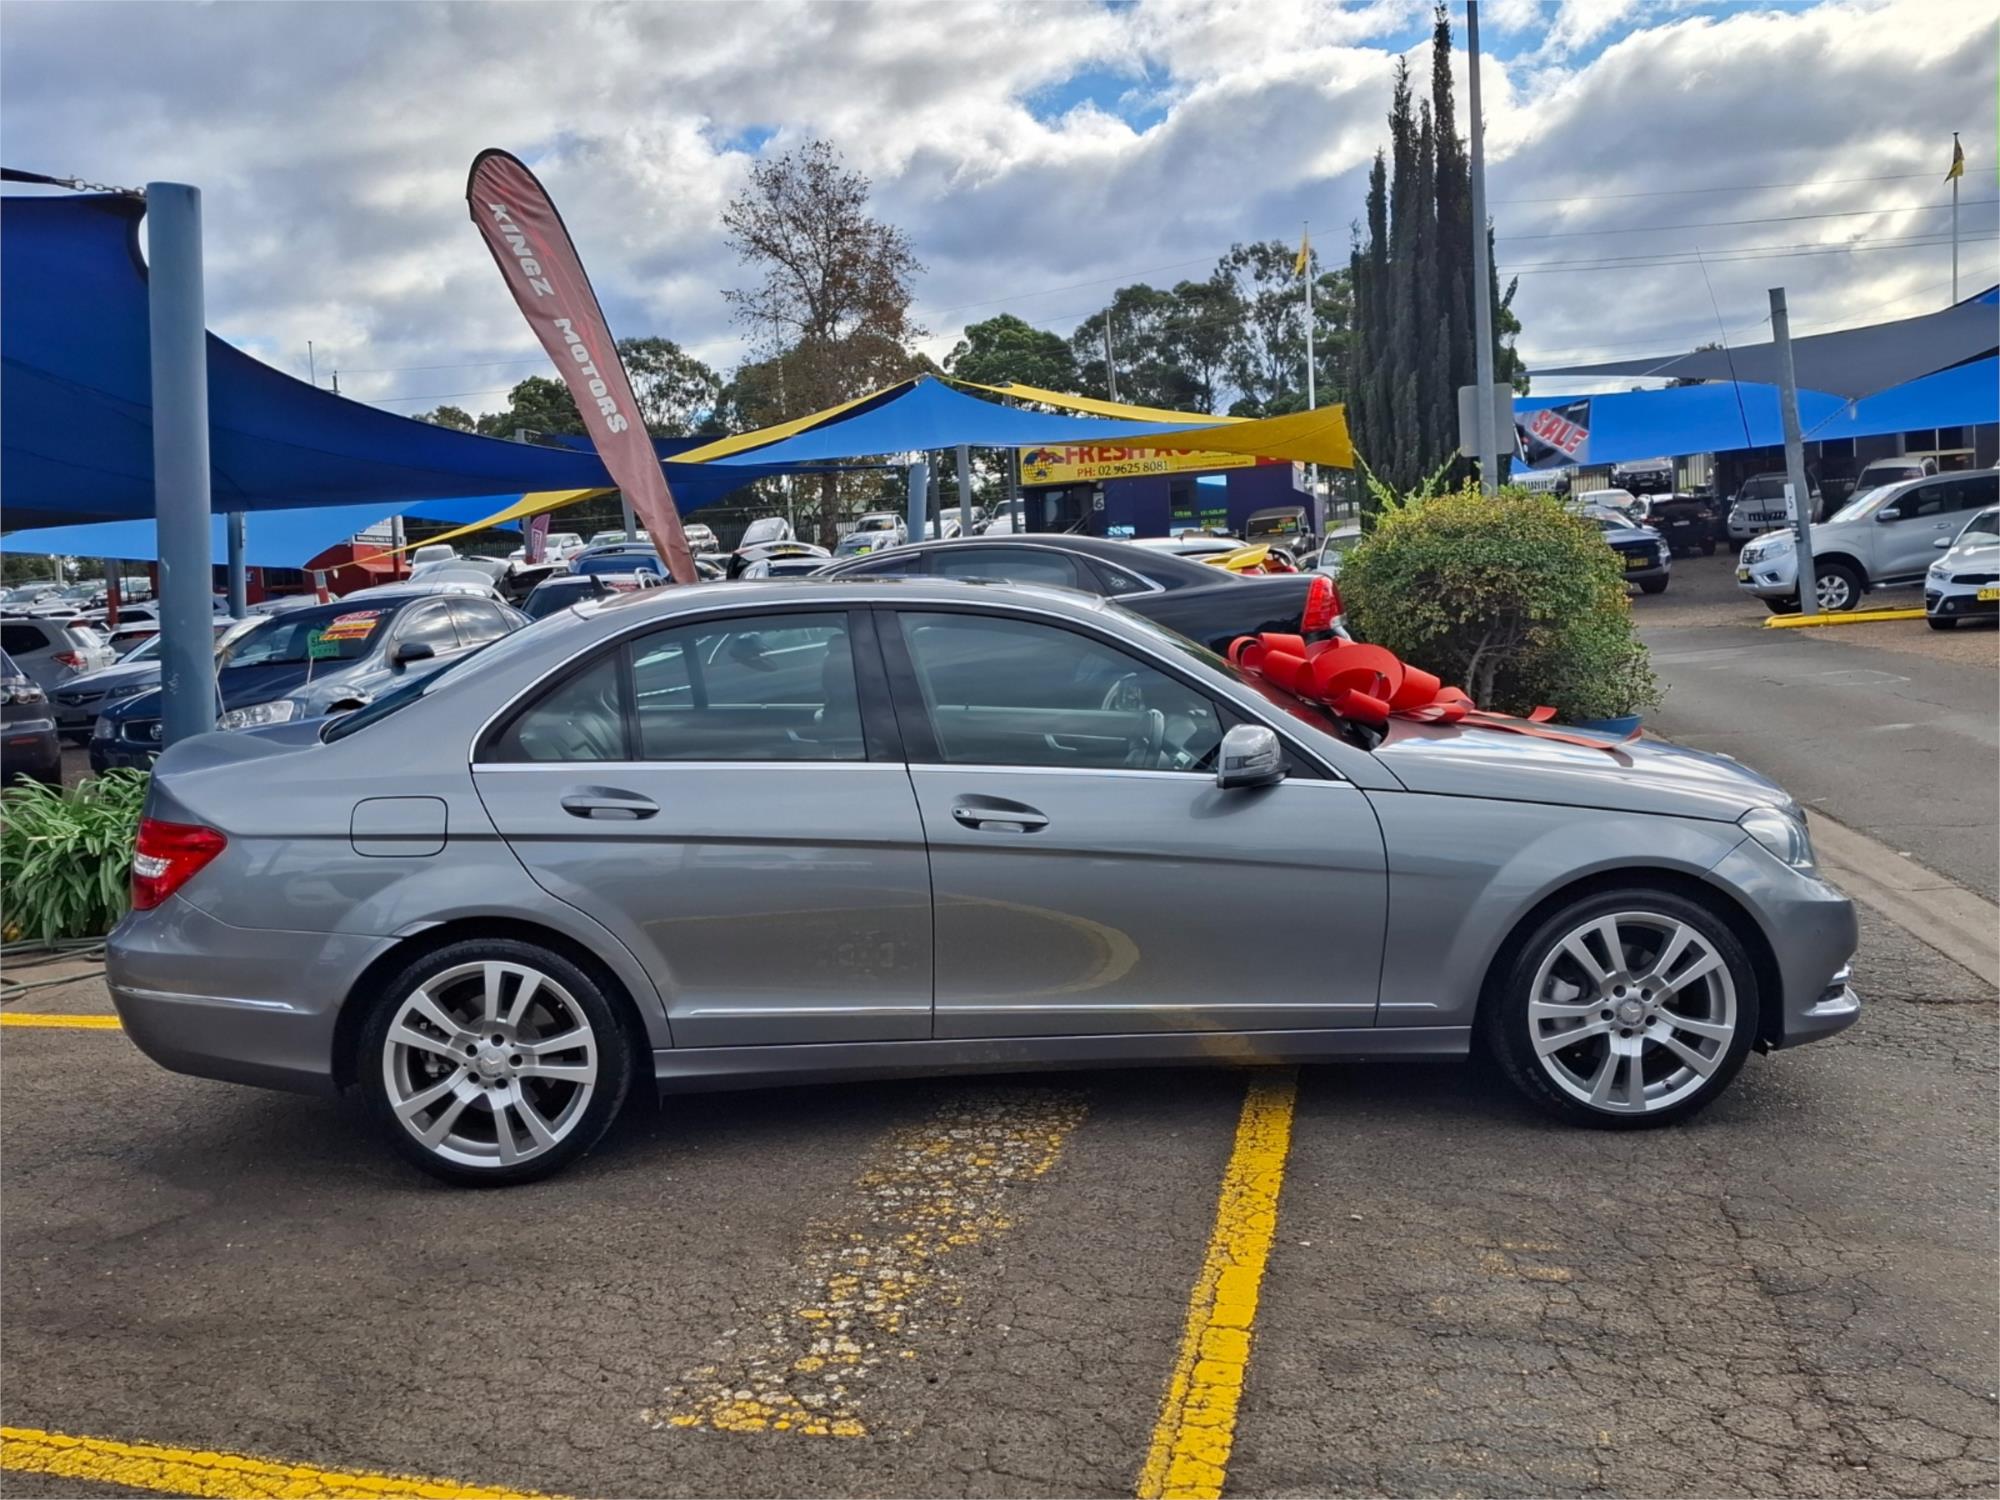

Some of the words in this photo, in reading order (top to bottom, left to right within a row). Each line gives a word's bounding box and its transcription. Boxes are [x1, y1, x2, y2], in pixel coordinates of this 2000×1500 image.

[488, 203, 554, 296] KINGZ
[554, 318, 628, 433] MOTORS
[1531, 409, 1588, 453] SALE
[1077, 466, 1096, 478] PH:
[1098, 465, 1111, 476] 02
[1114, 463, 1140, 473] 9625
[1143, 460, 1169, 472] 8081
